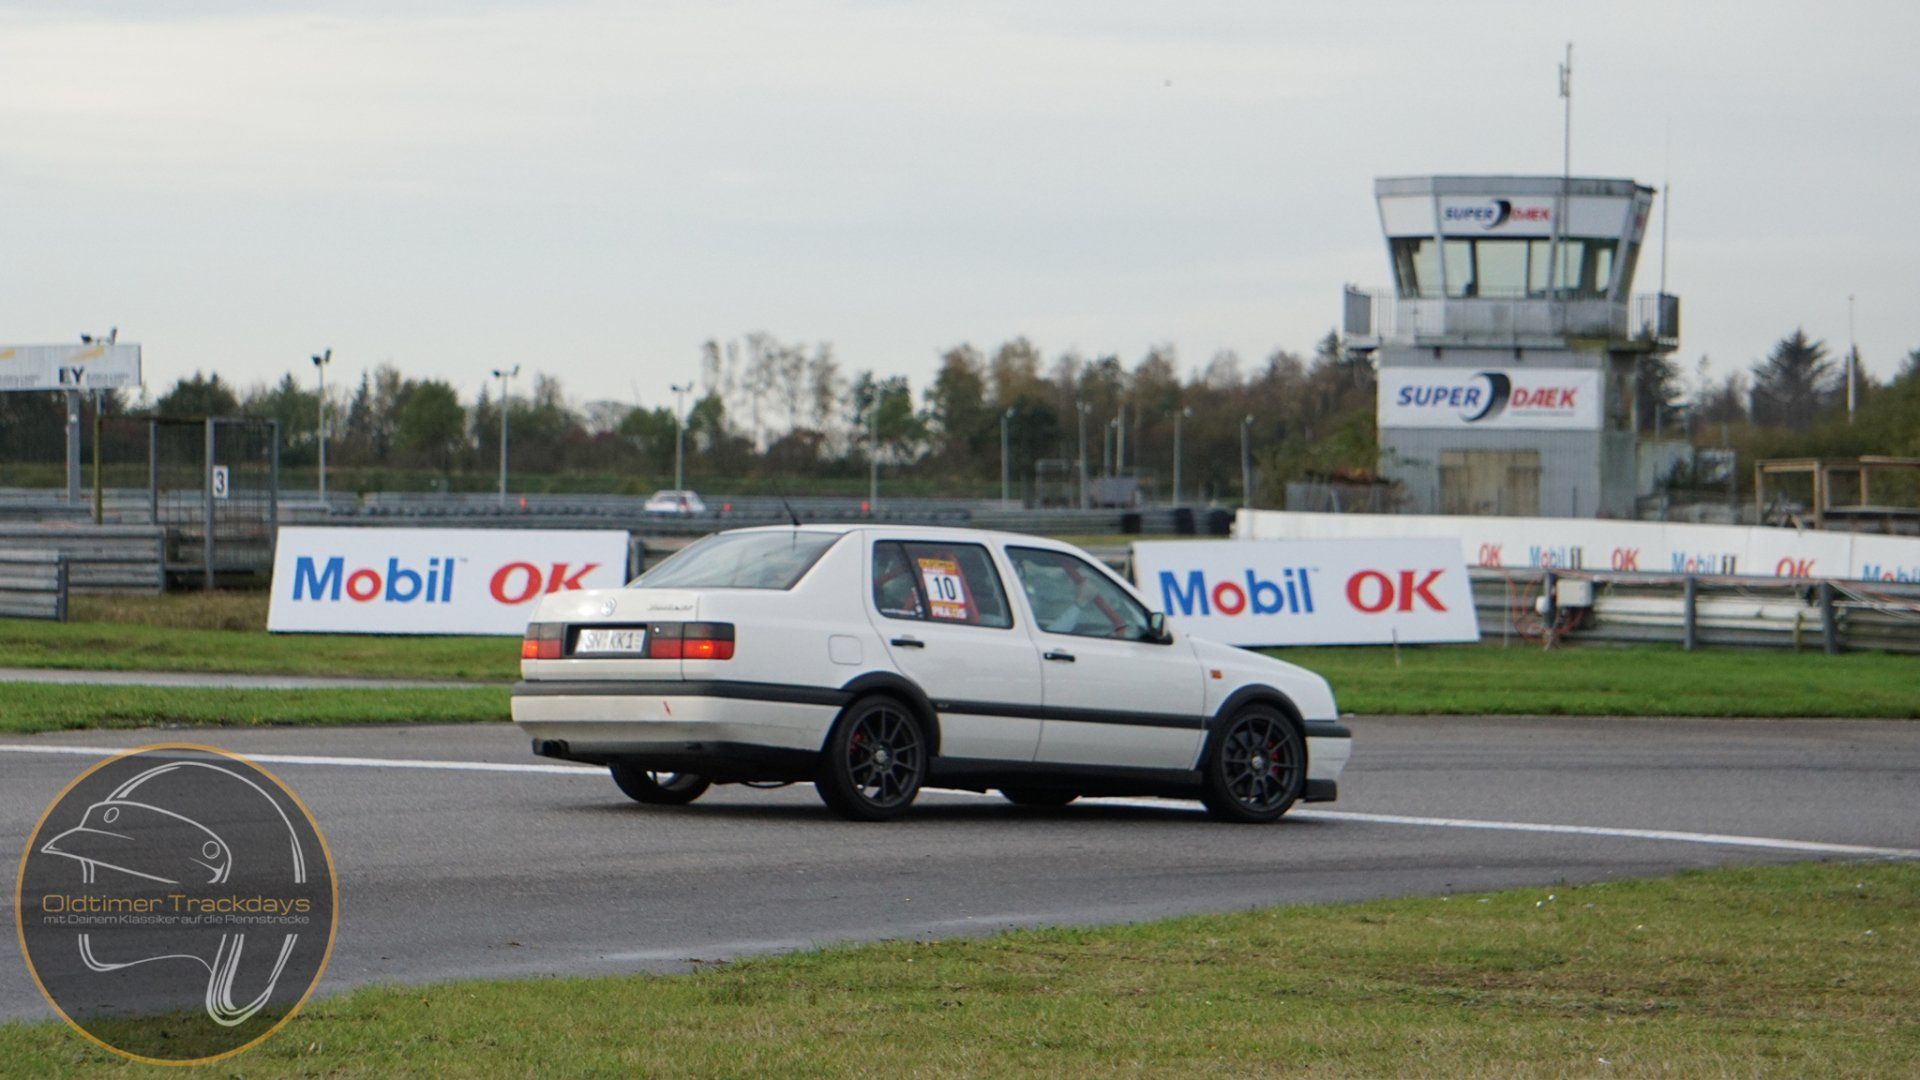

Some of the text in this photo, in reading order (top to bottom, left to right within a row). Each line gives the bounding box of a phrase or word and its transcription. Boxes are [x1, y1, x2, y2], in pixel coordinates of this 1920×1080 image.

[1444, 207, 1494, 219] SUPER
[1397, 384, 1482, 407] SUPER
[215, 470, 225, 494] 3
[1479, 543, 1503, 567] OK
[1611, 547, 1640, 571] OK
[1775, 556, 1817, 578] OK
[292, 555, 600, 605] Mobil OK
[933, 576, 957, 600] 10
[1158, 568, 1448, 616] Mobil OK
